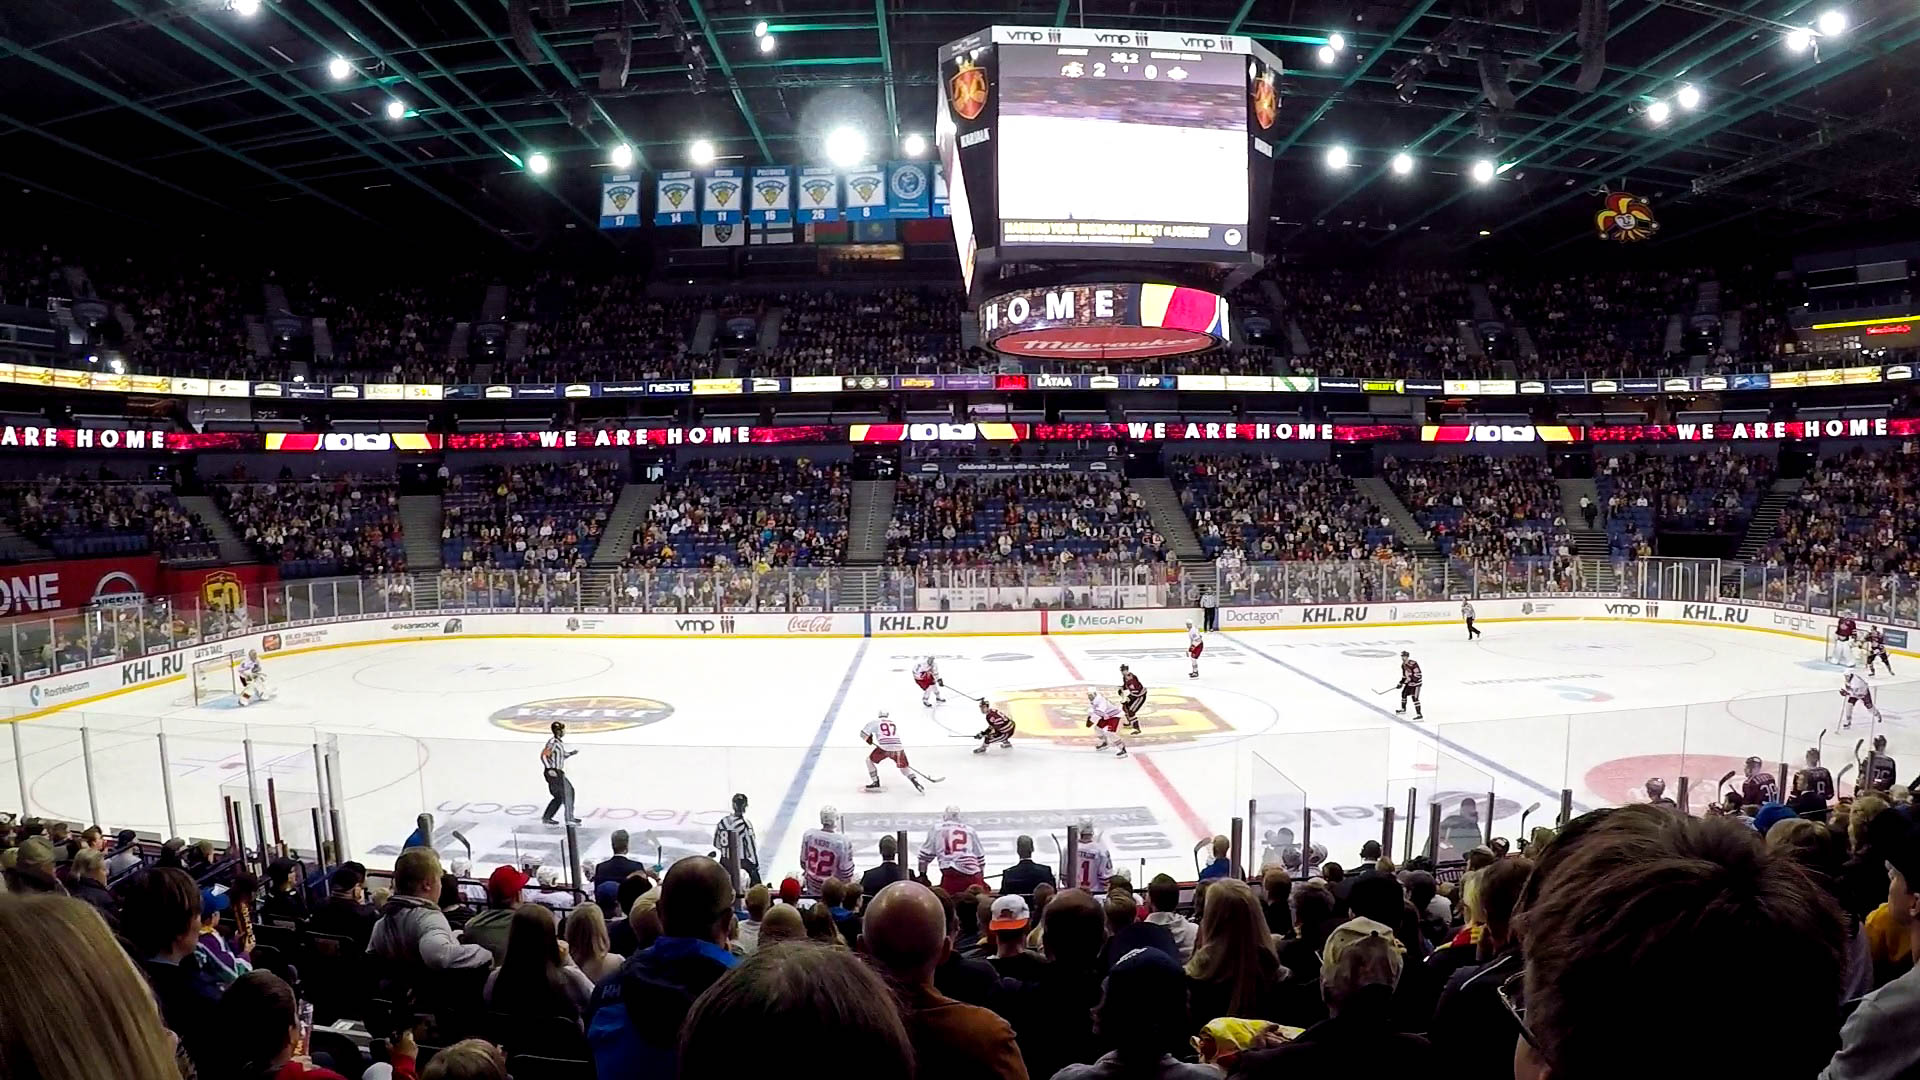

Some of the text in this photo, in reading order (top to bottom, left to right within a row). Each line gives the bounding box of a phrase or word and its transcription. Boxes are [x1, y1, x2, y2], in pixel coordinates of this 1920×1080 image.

[1007, 31, 1043, 42] vmp
[1095, 33, 1130, 44] vmp
[1181, 37, 1215, 48] vmp
[1093, 63, 1106, 77] 2
[717, 211, 728, 222] 11
[811, 210, 824, 221] 26
[986, 290, 1114, 332] HOME
[649, 383, 690, 393] NESTE
[1128, 422, 1333, 440] WE ARE HOME
[1677, 418, 1888, 440] WE ARE HOME
[1, 426, 165, 449] ARE HOME
[540, 426, 750, 448] WE ARE HOME
[1302, 607, 1368, 623] KHL.RU
[1605, 604, 1640, 618] vmp
[1683, 604, 1748, 623] KHL.RU
[676, 620, 714, 634] vmp
[880, 616, 949, 631] KHL.RU
[122, 653, 184, 685] KHL.RU
[880, 722, 896, 737] 97
[943, 830, 967, 855] 12
[808, 846, 835, 877] 22
